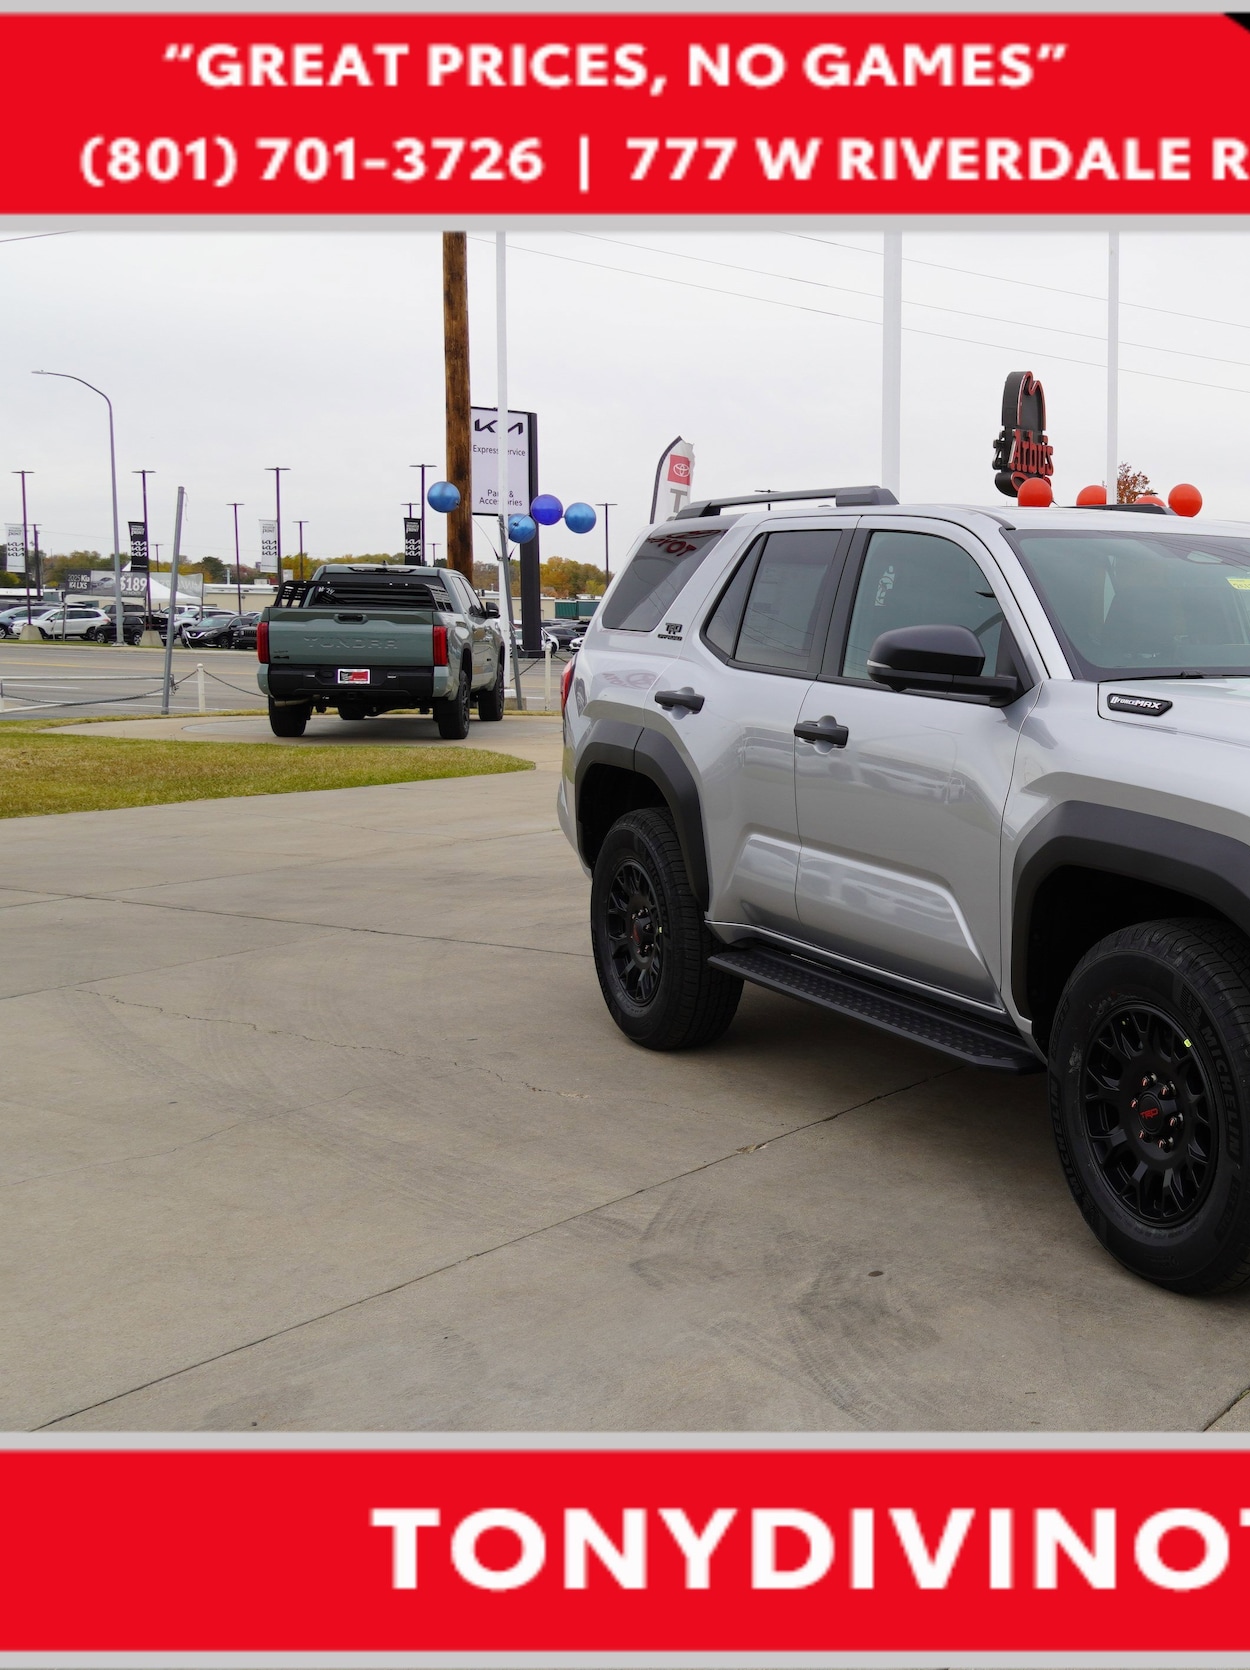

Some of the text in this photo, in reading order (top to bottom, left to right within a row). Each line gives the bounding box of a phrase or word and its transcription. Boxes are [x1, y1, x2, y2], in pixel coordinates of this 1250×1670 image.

[505, 449, 526, 457] rvice
[479, 497, 523, 507] Acceries
[120, 576, 147, 592] $189
[1202, 1026, 1240, 1155] MICHELIN
[1140, 1107, 1158, 1119] TRD
